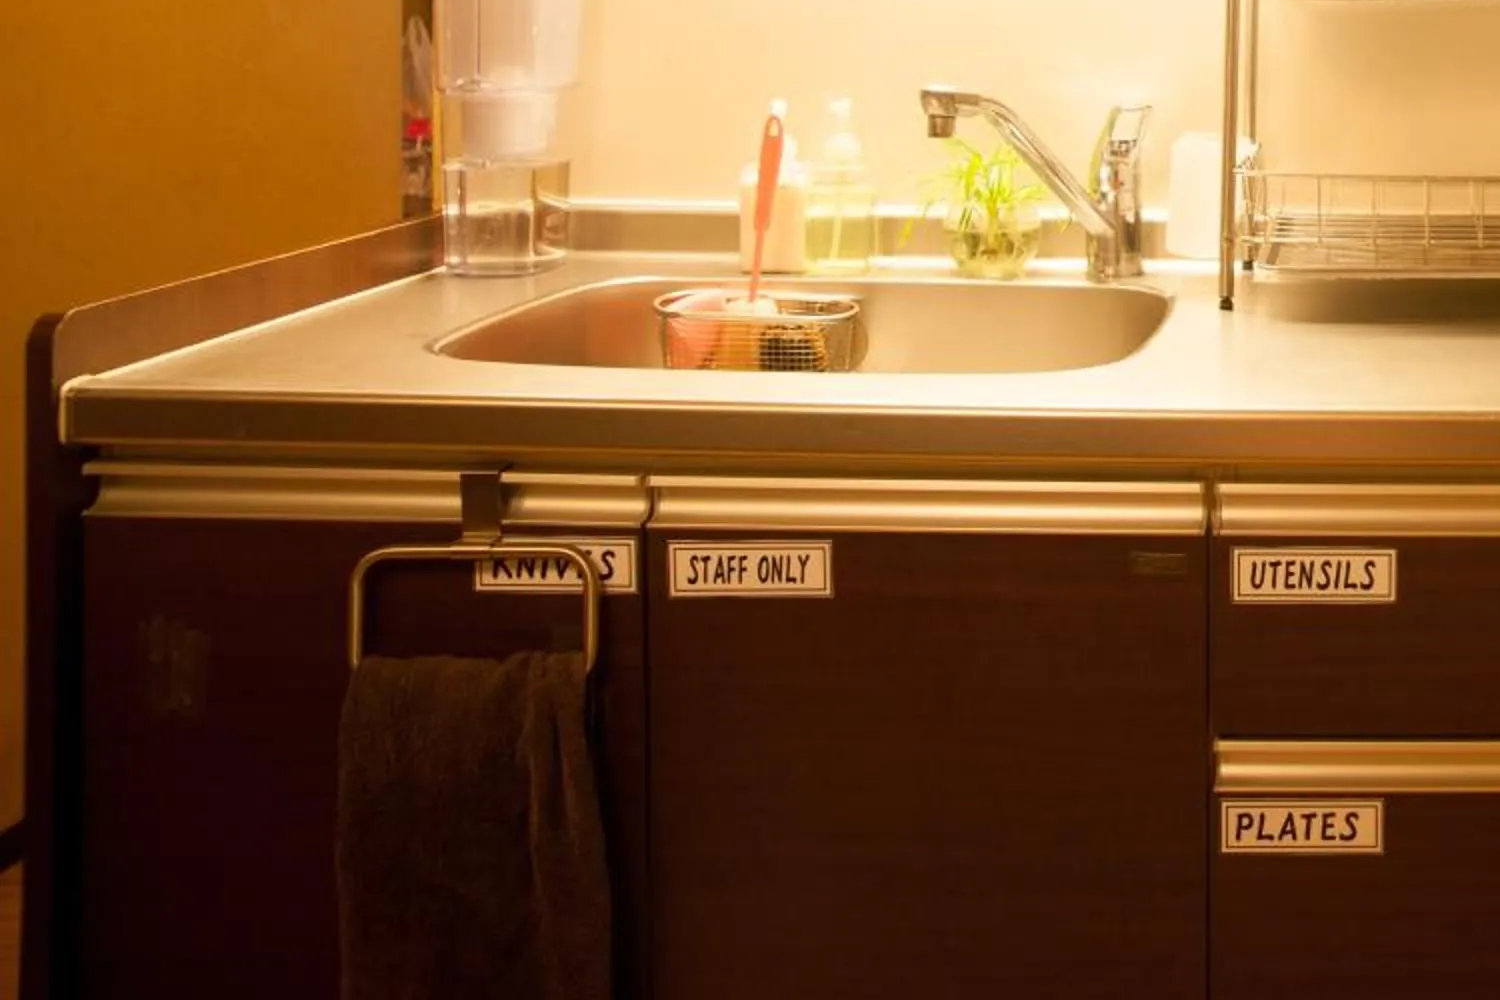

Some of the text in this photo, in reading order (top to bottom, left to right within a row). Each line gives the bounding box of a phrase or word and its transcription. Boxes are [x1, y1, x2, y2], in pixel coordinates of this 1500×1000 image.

[687, 553, 812, 586] STAFF ONLY
[1250, 559, 1377, 591] UTENSILS
[1234, 811, 1360, 842] PLATES
